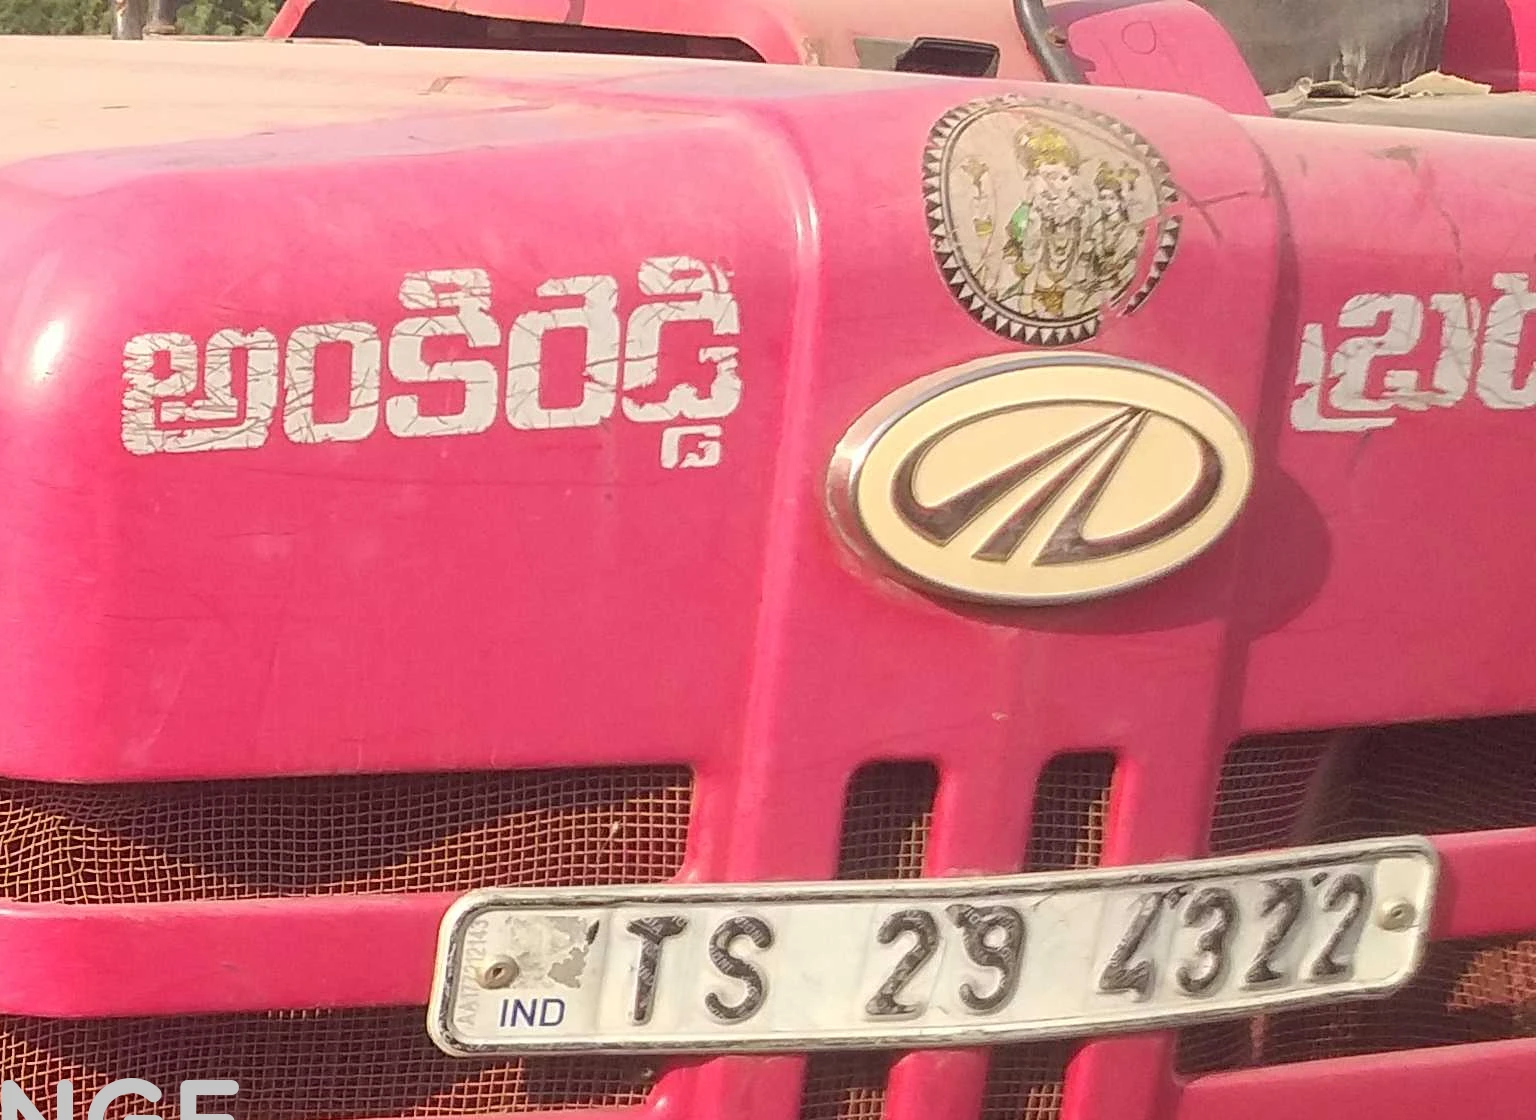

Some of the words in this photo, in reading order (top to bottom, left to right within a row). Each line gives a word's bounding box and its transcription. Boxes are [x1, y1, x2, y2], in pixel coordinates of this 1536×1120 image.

[626, 915, 774, 1024] TS
[864, 903, 1025, 1017] 29
[1097, 872, 1368, 1000] 4322
[499, 997, 566, 1028] IND
